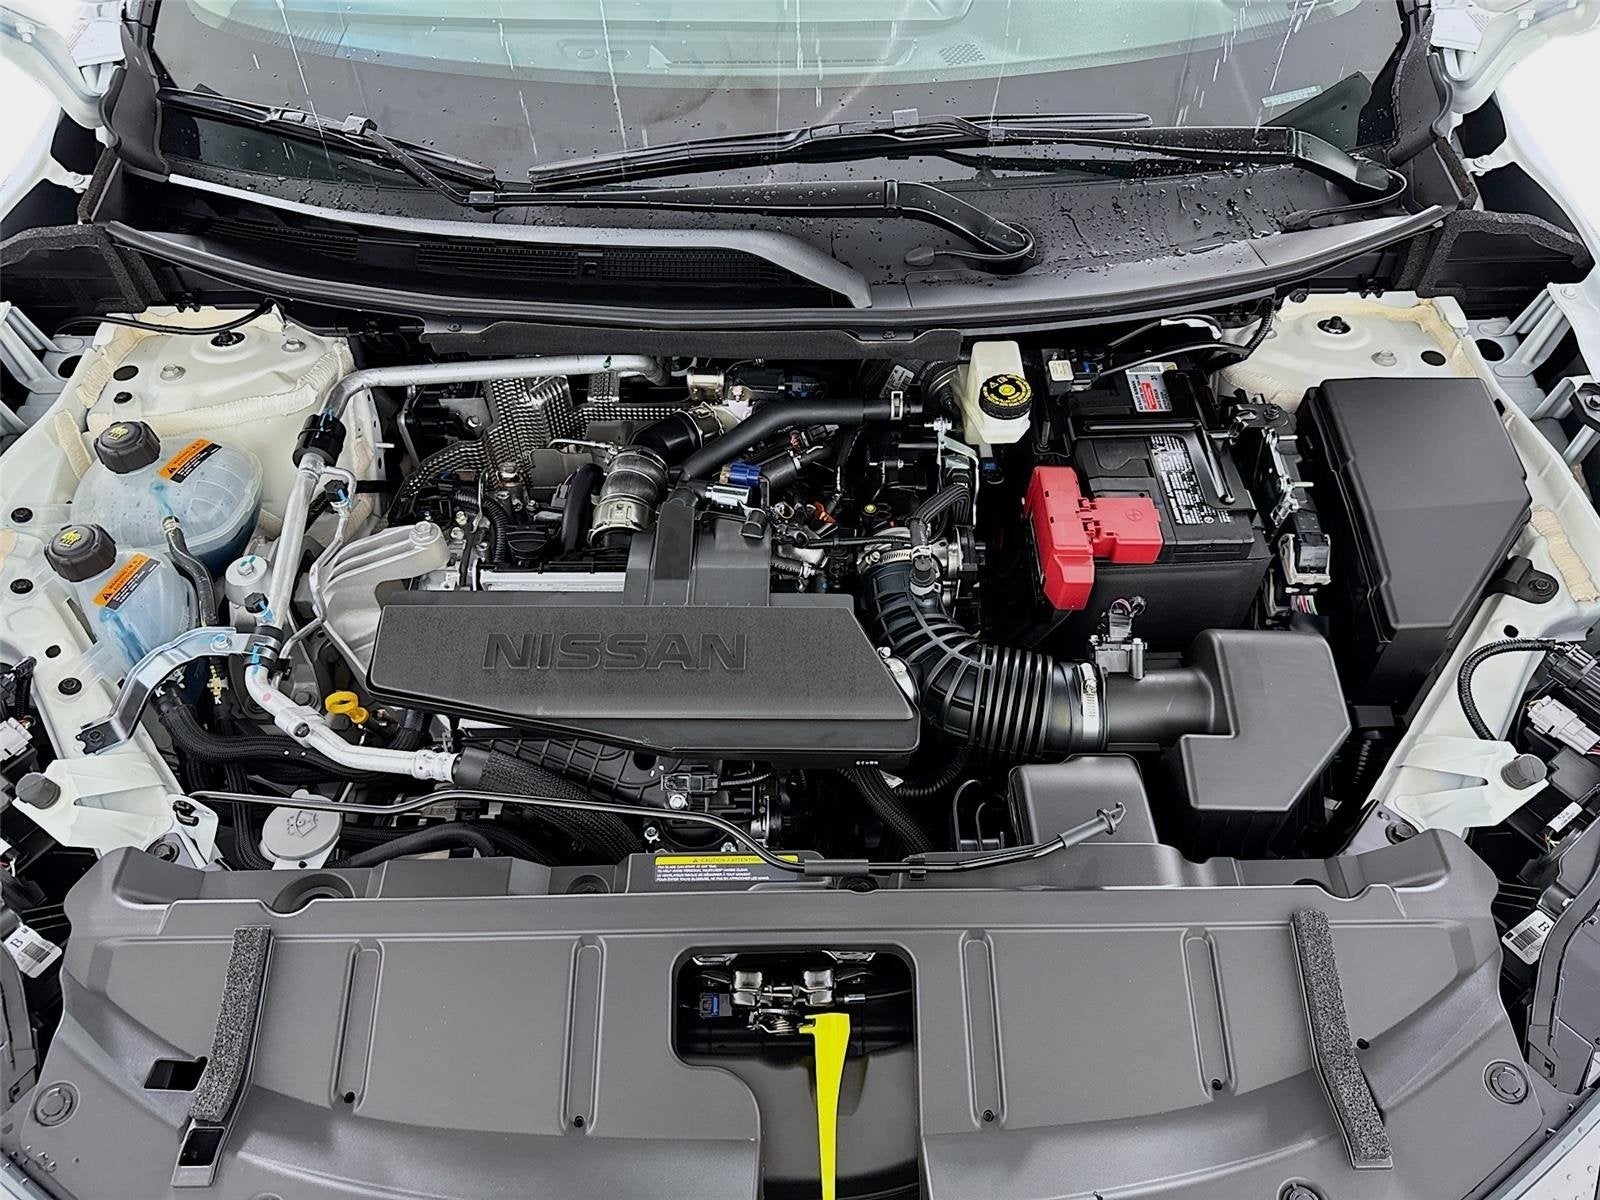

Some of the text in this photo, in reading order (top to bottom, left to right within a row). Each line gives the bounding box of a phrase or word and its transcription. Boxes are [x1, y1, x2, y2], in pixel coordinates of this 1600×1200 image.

[482, 632, 747, 670] NISSAN
[1538, 921, 1550, 932] B
[10, 938, 24, 949] B
